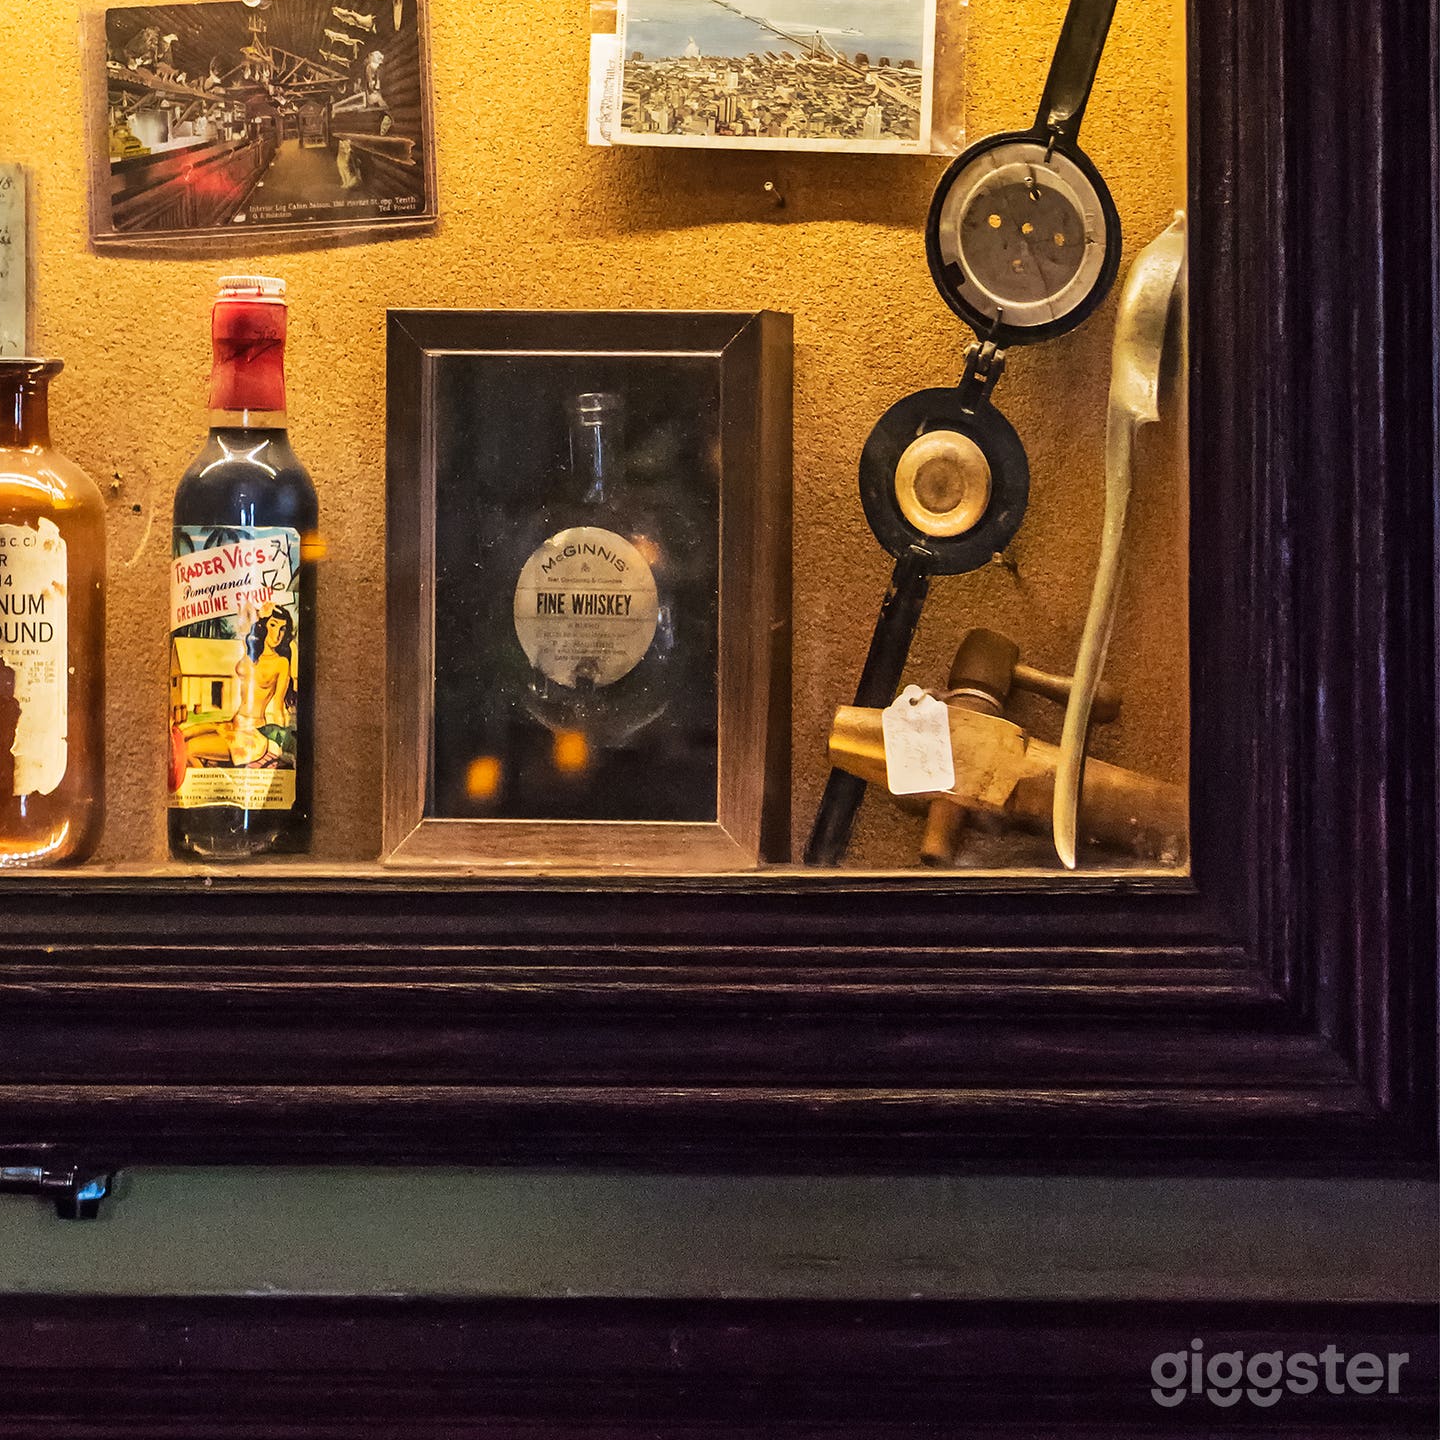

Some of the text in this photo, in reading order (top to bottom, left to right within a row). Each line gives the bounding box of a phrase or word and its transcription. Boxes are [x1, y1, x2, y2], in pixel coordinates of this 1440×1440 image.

[175, 555, 227, 585] TRADER
[176, 595, 229, 623] GRENADINE
[235, 586, 275, 610] SYRUP
[536, 592, 633, 617] FINE WHISKEY
